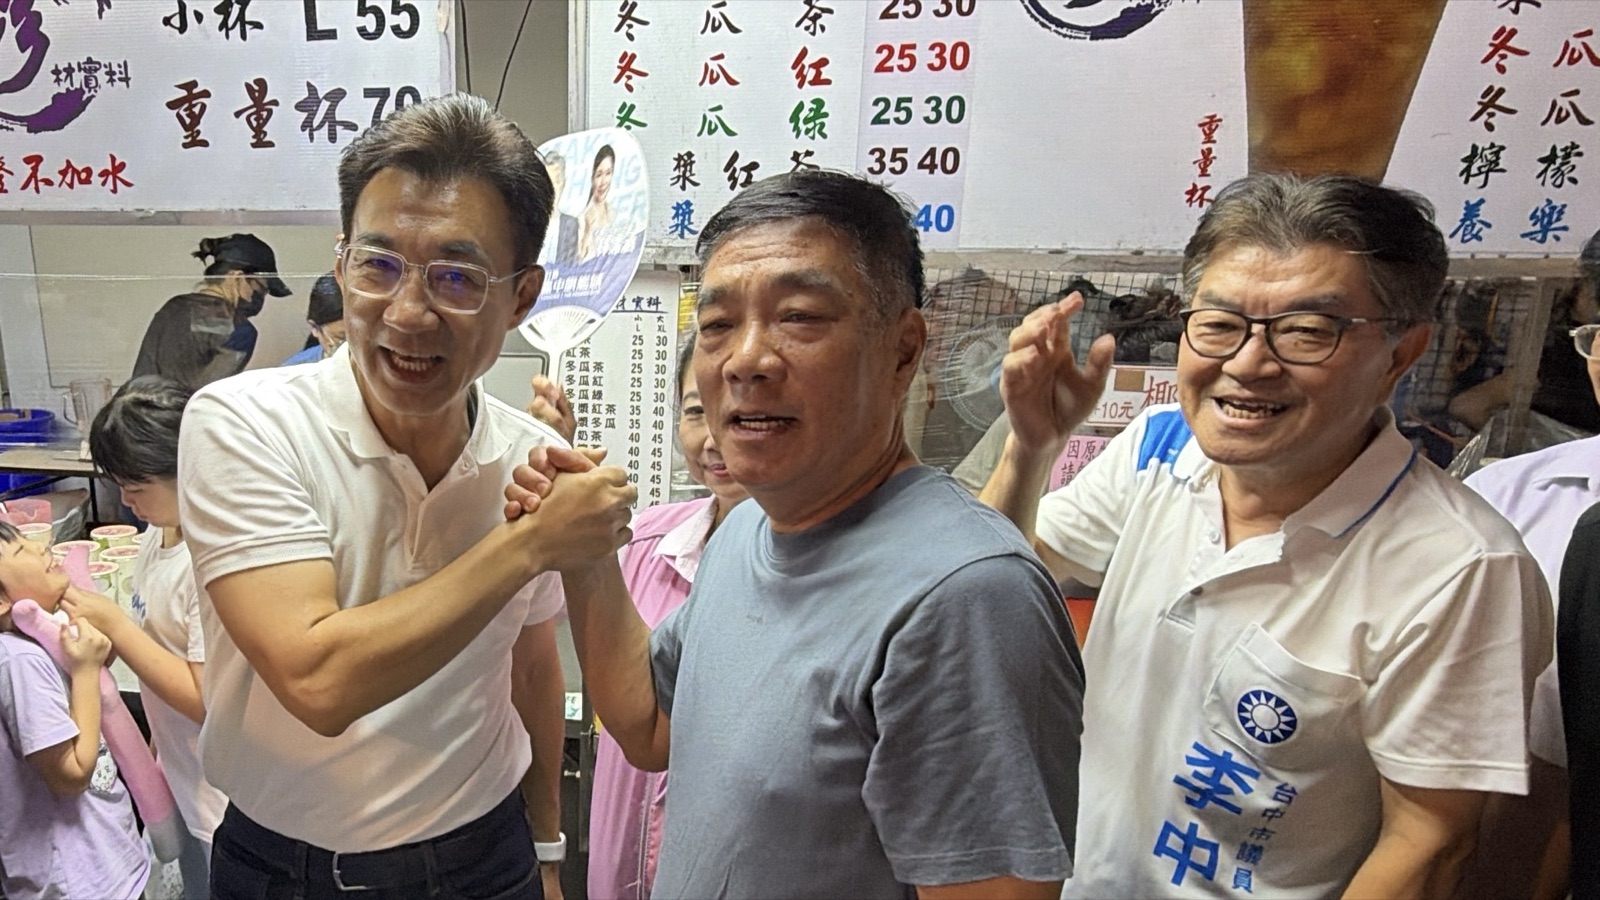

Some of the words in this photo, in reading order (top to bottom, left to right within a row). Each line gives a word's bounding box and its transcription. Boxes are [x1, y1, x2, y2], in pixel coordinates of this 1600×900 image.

[879, 0, 923, 19] 25
[932, 0, 977, 18] 30
[162, 0, 264, 41] 小杯
[306, 0, 338, 41] L
[355, 0, 420, 41] 55
[874, 43, 917, 73] 25
[928, 41, 970, 71] 30
[1480, 25, 1600, 74] 冬瓜
[166, 77, 358, 150] 重量杯
[871, 97, 913, 126] 25
[924, 95, 966, 125] 30
[1469, 84, 1595, 132] 冬瓜
[867, 147, 909, 175] 35
[918, 147, 961, 175] 40
[1184, 113, 1223, 208] 重量杯
[1459, 141, 1584, 189] 檸檬
[913, 204, 955, 232] 40
[1449, 198, 1570, 244] 養樂
[636, 324, 641, 332] L
[657, 325, 666, 333] XL
[632, 335, 644, 346] 25
[656, 336, 667, 346] 30
[631, 349, 643, 360] 25
[655, 350, 667, 361] 30
[631, 363, 643, 374] 25
[655, 364, 666, 375] 30
[630, 377, 642, 388] 25
[654, 378, 666, 389] 30
[630, 391, 641, 402] 25
[653, 393, 665, 403] 30
[629, 405, 641, 415] 35
[653, 406, 664, 417] 40
[629, 419, 640, 429] 35
[652, 420, 664, 430] 40
[628, 433, 640, 443] 40
[652, 434, 663, 444] 45
[628, 447, 639, 457] 40
[651, 448, 662, 458] 45
[628, 460, 639, 470] 40
[650, 461, 662, 471] 45
[650, 474, 661, 484] 45
[649, 488, 660, 498] 45
[1153, 741, 1261, 886] 李中
[1232, 782, 1298, 894] 台中市議員
